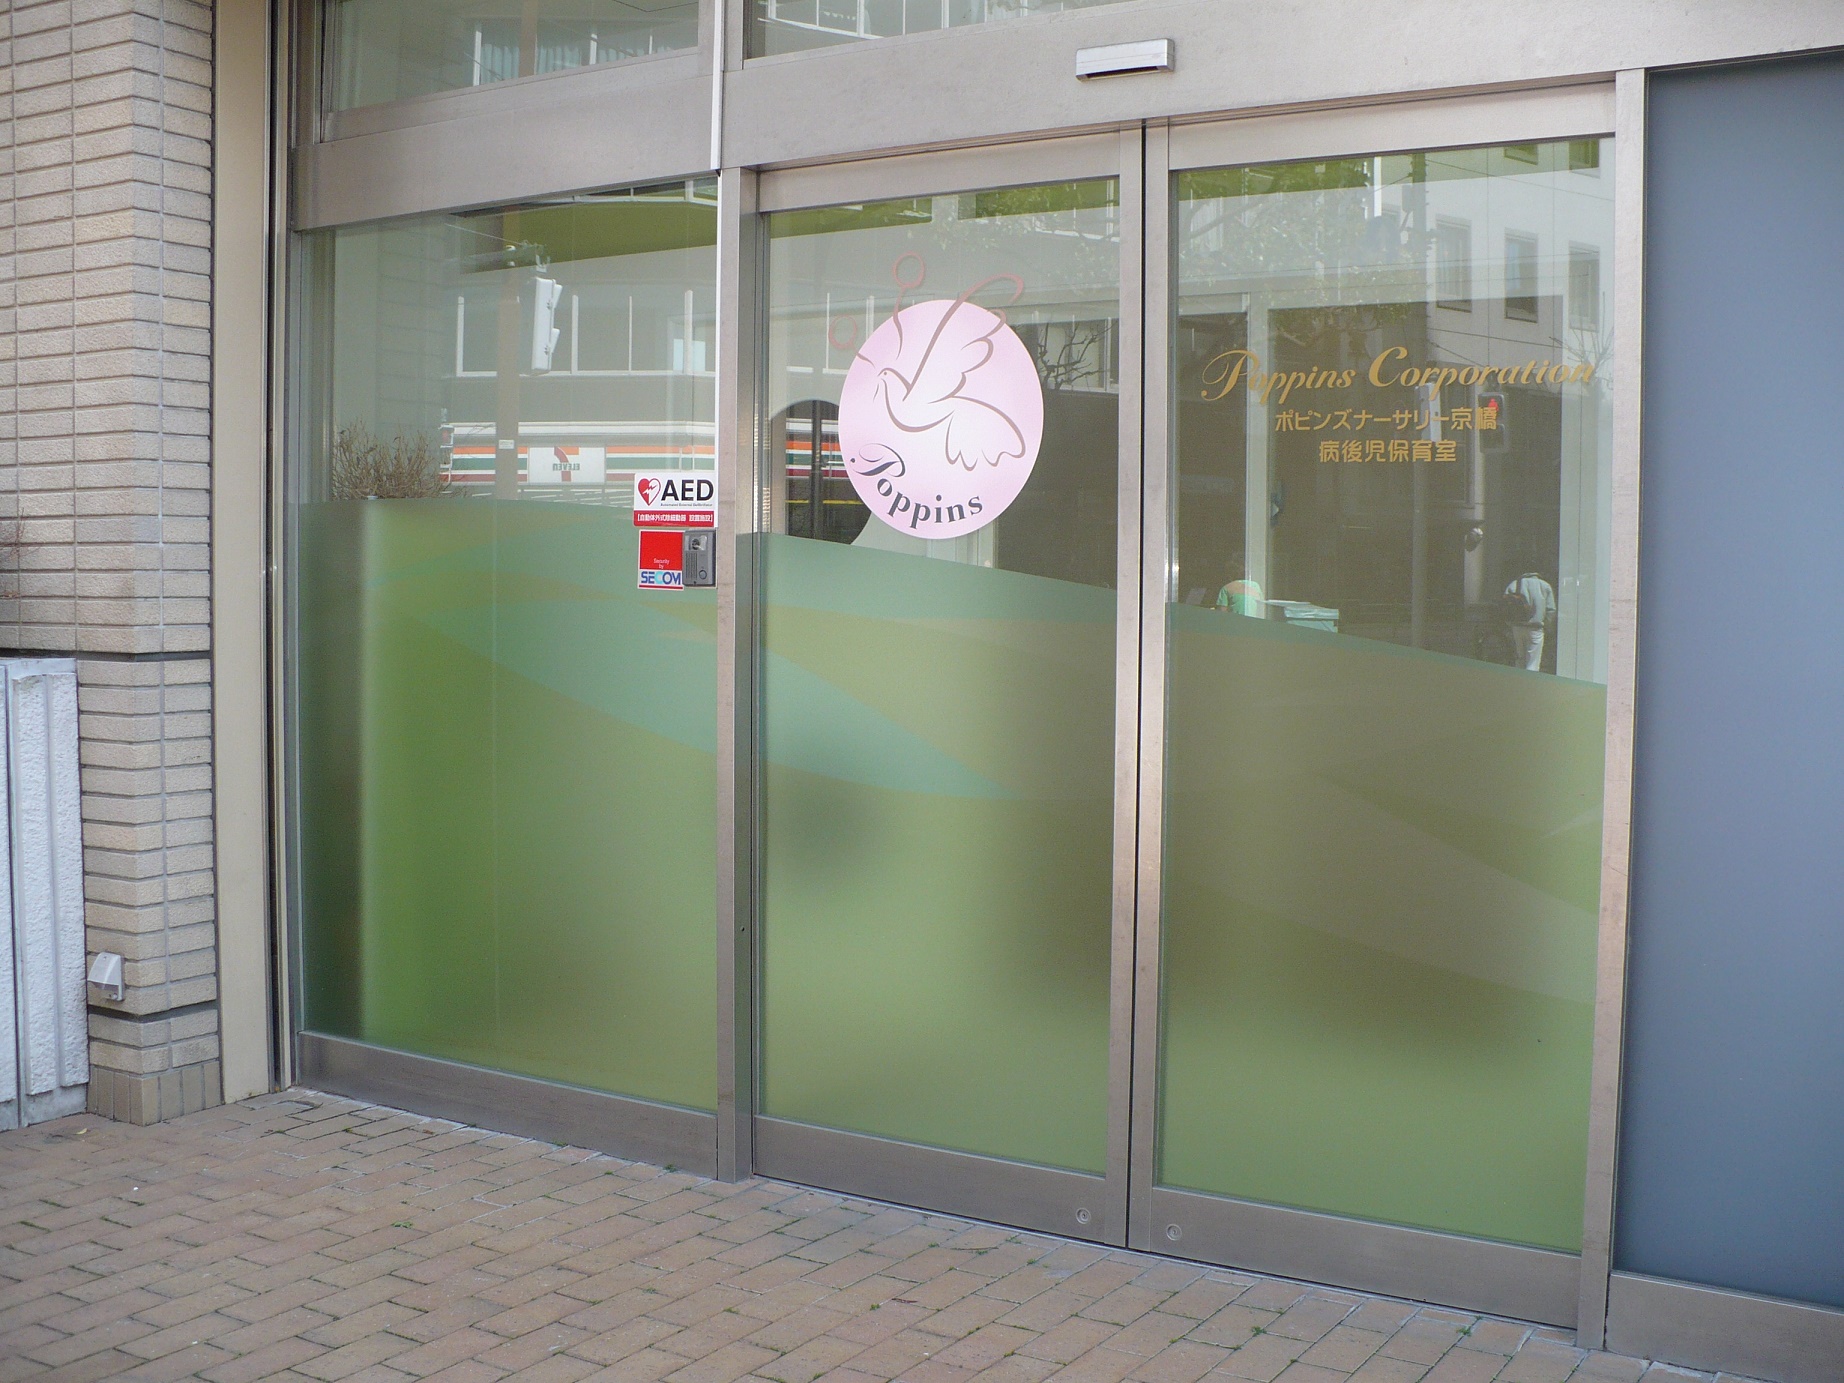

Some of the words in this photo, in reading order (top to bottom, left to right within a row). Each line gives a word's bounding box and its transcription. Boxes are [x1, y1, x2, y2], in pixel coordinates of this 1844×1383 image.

[1201, 349, 1358, 405] Poppins
[1368, 346, 1596, 401] Corporation
[1275, 406, 1498, 432] ポピンズナーサリー京橋
[1318, 439, 1457, 463] 病後児保育室
[661, 479, 714, 501] AED
[850, 443, 983, 530] Poppins
[640, 571, 681, 585] SECOM
